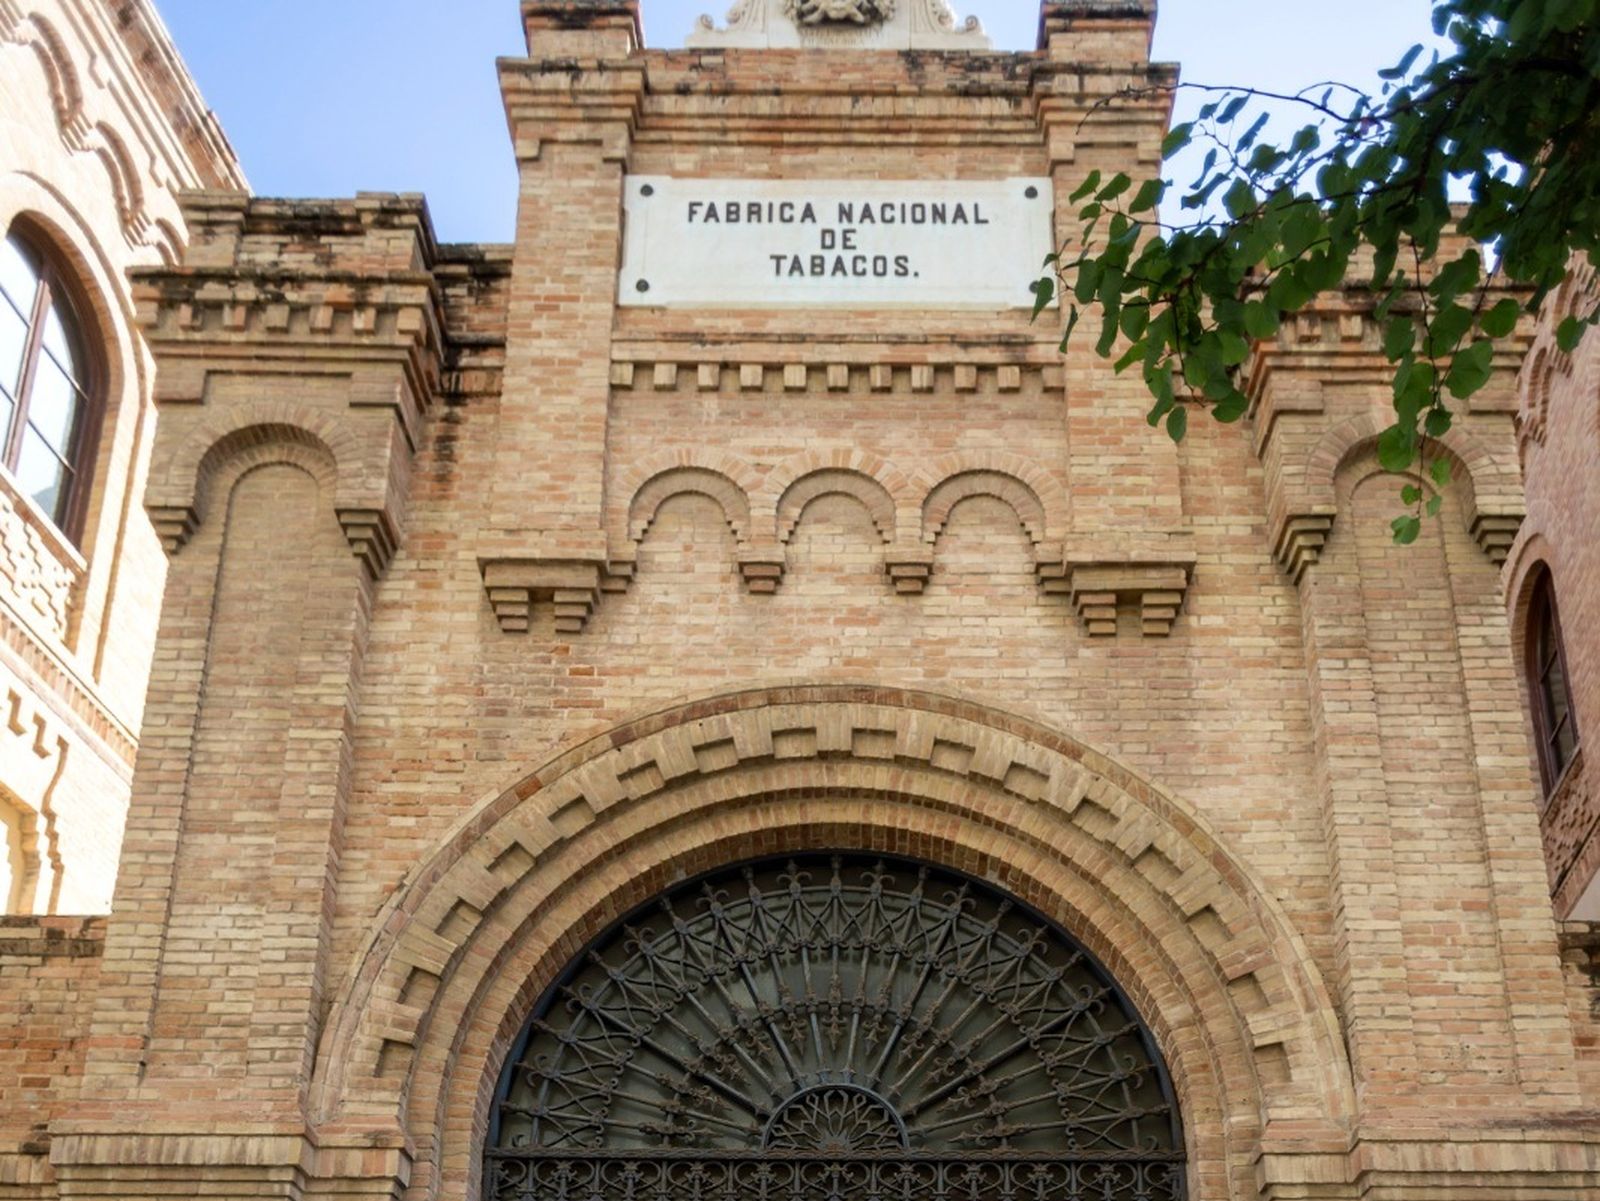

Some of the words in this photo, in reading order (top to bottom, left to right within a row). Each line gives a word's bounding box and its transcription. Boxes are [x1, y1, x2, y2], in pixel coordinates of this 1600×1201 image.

[688, 202, 816, 223] FABRICA
[838, 203, 989, 224] NACIONAL
[821, 229, 857, 250] DE
[770, 255, 919, 277] TABACOS.
